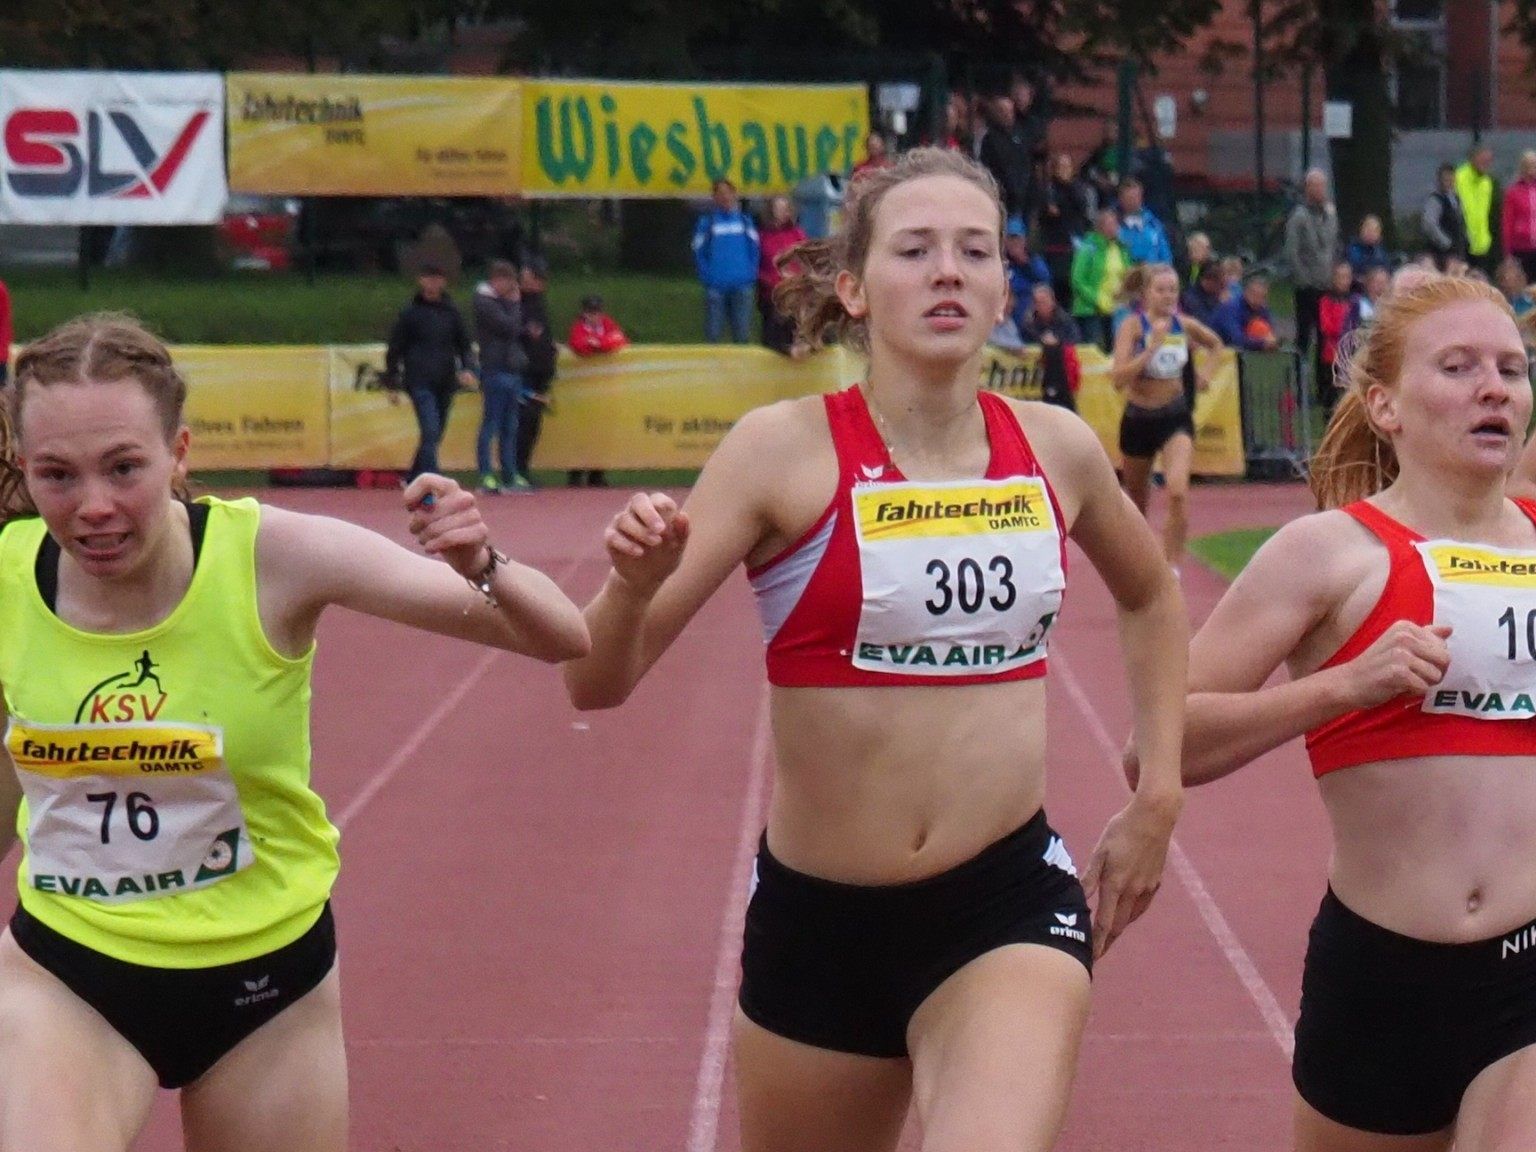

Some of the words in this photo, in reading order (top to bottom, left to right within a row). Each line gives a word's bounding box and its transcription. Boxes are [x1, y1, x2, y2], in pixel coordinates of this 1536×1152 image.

[5, 110, 209, 198] SLV
[535, 94, 858, 187] Wiesbauer
[876, 495, 1033, 522] fahrtechnik
[925, 555, 1017, 616] 303
[89, 693, 168, 724] KSV
[22, 739, 200, 762] fahrtechnik
[86, 791, 161, 845] 76
[1050, 926, 1086, 942] erima
